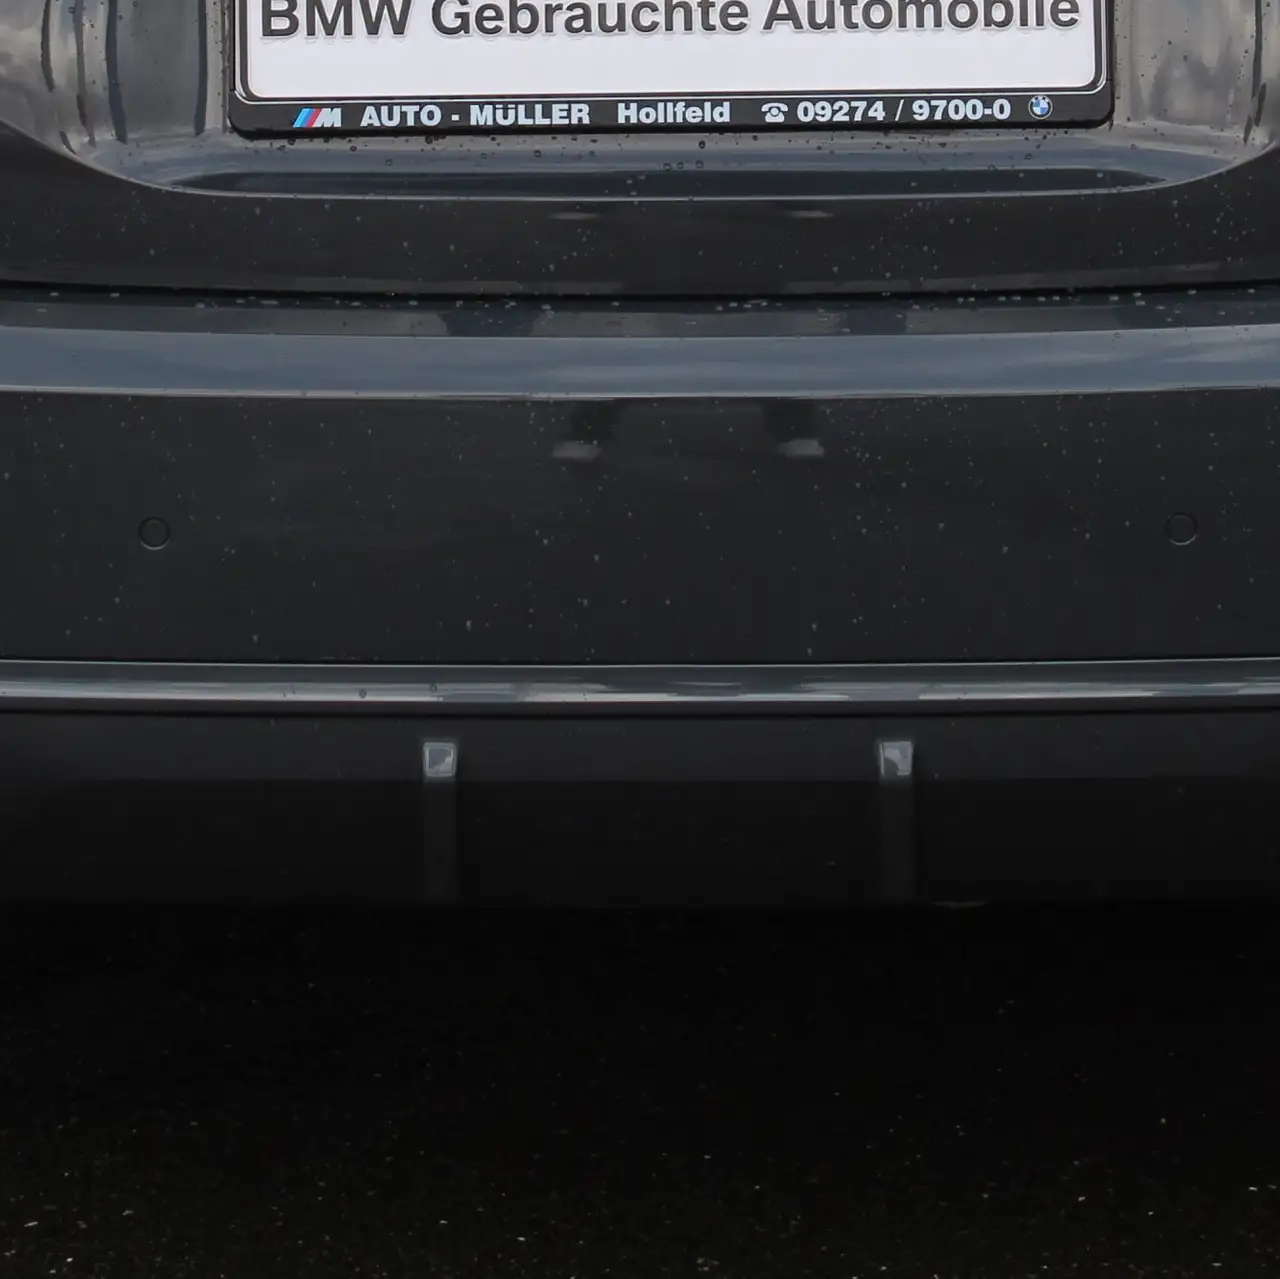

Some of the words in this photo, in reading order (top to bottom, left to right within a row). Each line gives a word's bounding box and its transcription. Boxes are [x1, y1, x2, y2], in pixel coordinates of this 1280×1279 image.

[360, 104, 442, 127] AUTO
[469, 102, 590, 126] MÜLLER
[617, 101, 731, 124] Hollfeld
[796, 100, 886, 123] 09274
[894, 99, 905, 122] /
[912, 98, 1011, 122] 9700-0
